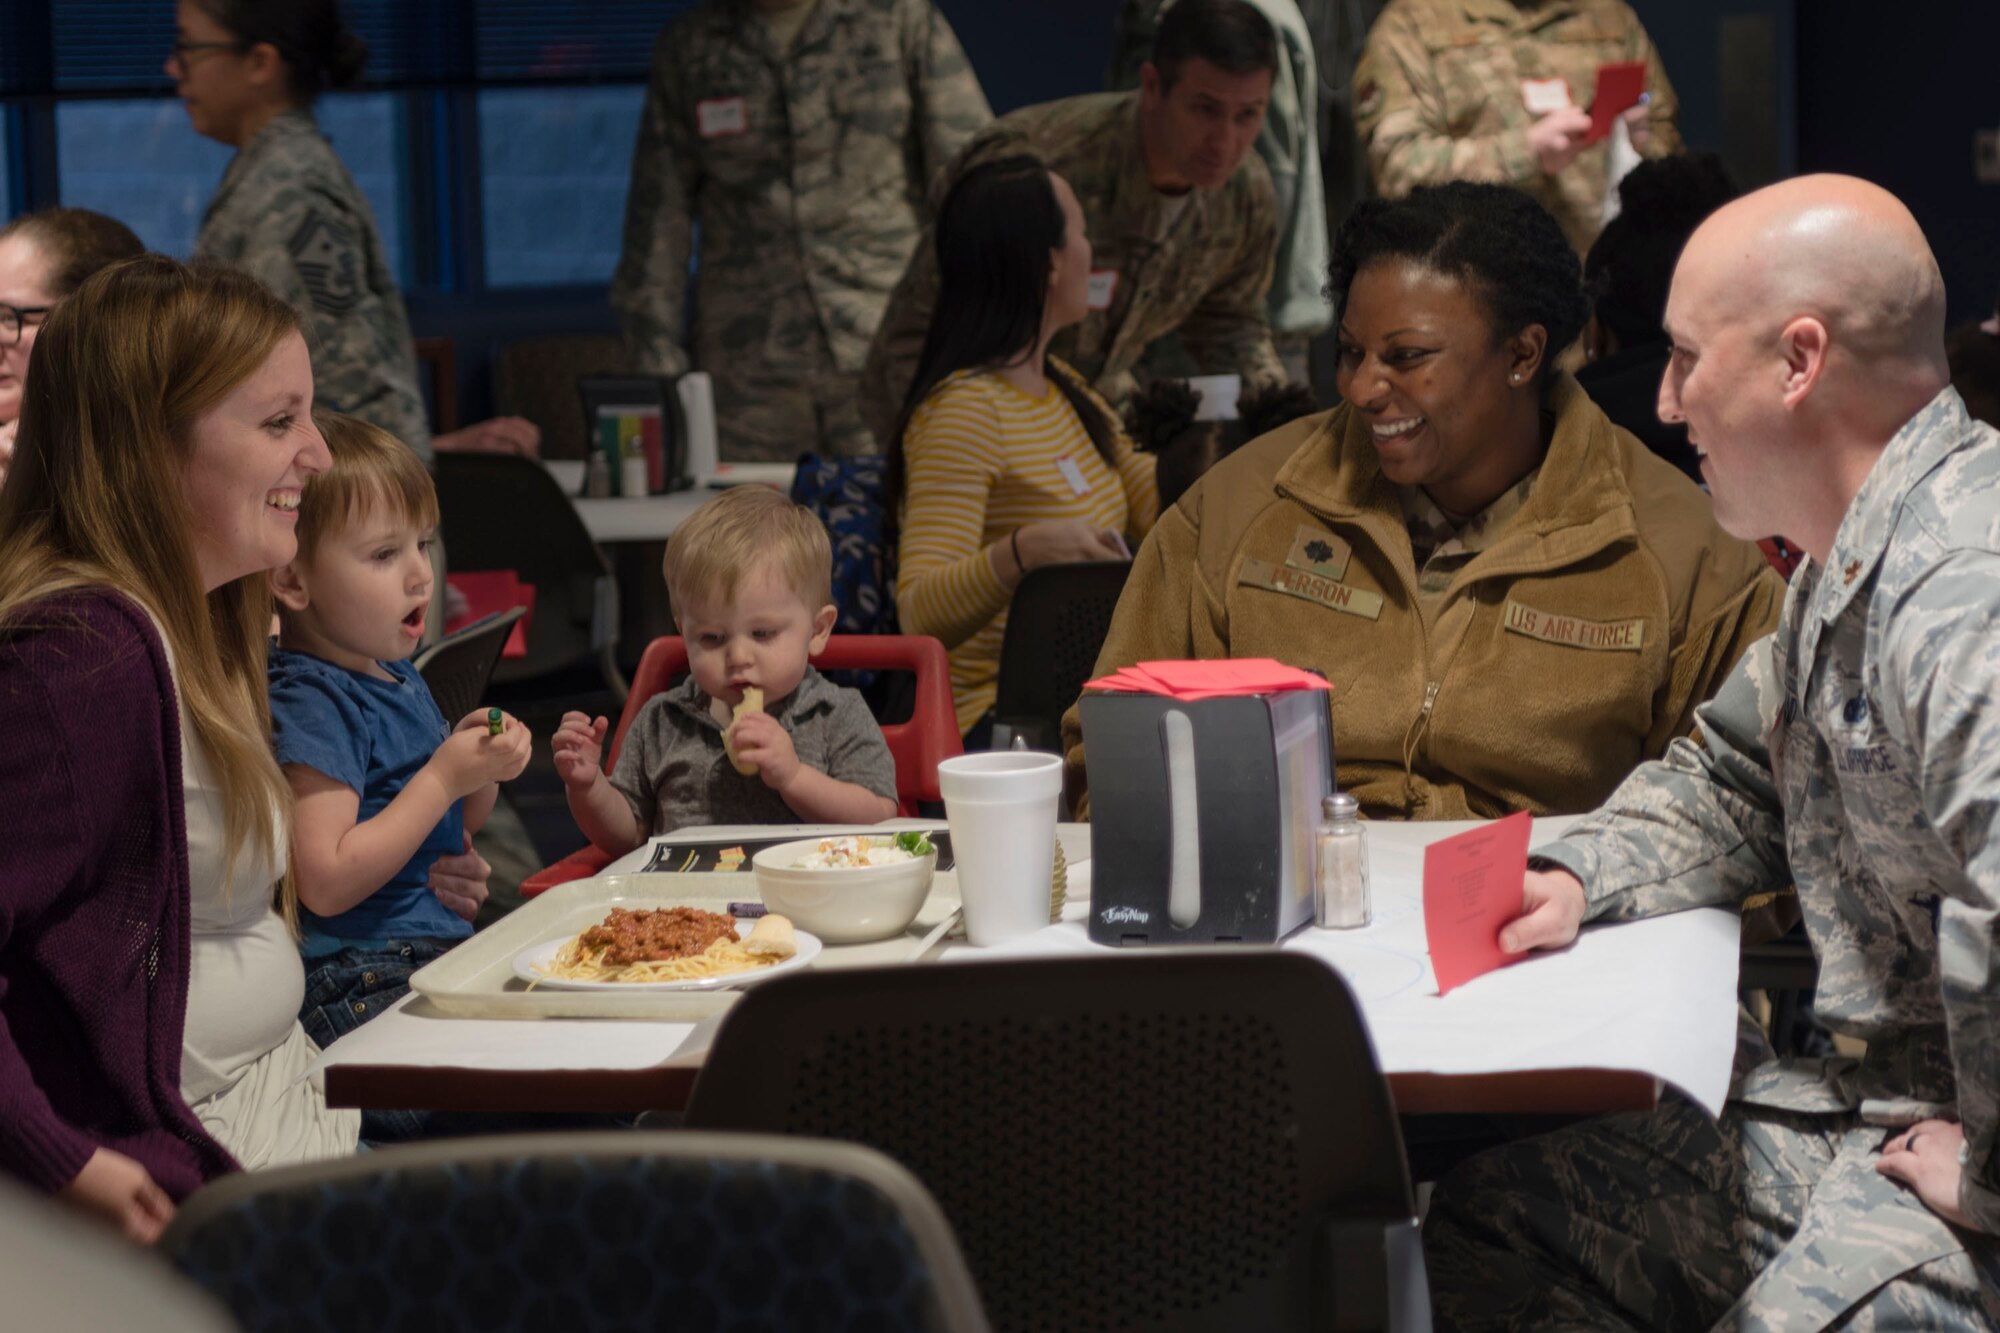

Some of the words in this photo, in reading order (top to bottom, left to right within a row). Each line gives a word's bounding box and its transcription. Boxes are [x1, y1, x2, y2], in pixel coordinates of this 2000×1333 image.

[1510, 605, 1537, 633] US
[1542, 617, 1575, 641] AIR
[1579, 623, 1635, 648] FORCE
[1106, 906, 1149, 924] EasyNap
